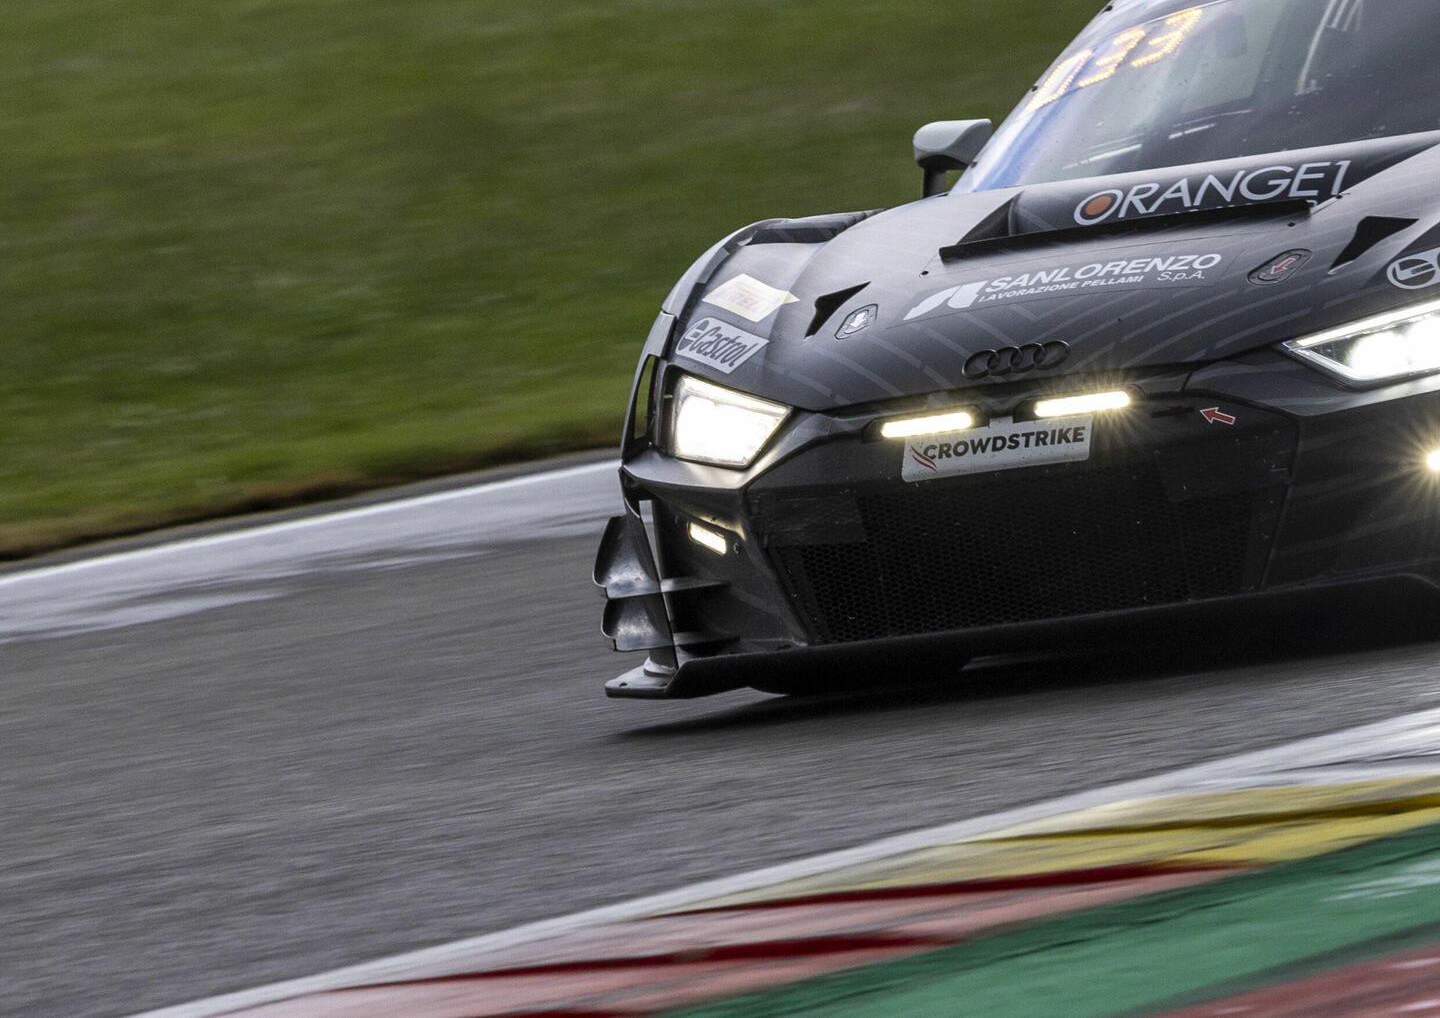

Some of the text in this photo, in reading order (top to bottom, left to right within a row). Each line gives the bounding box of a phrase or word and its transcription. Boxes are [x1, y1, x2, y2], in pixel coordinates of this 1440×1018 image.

[1074, 160, 1351, 226] ORANGE1
[977, 274, 1144, 303] LAVORAZIONE PELLAMI
[985, 253, 1222, 293] SANLORENZO
[689, 325, 758, 368] Castrol
[922, 426, 1087, 461] CROWDSTRIKE
